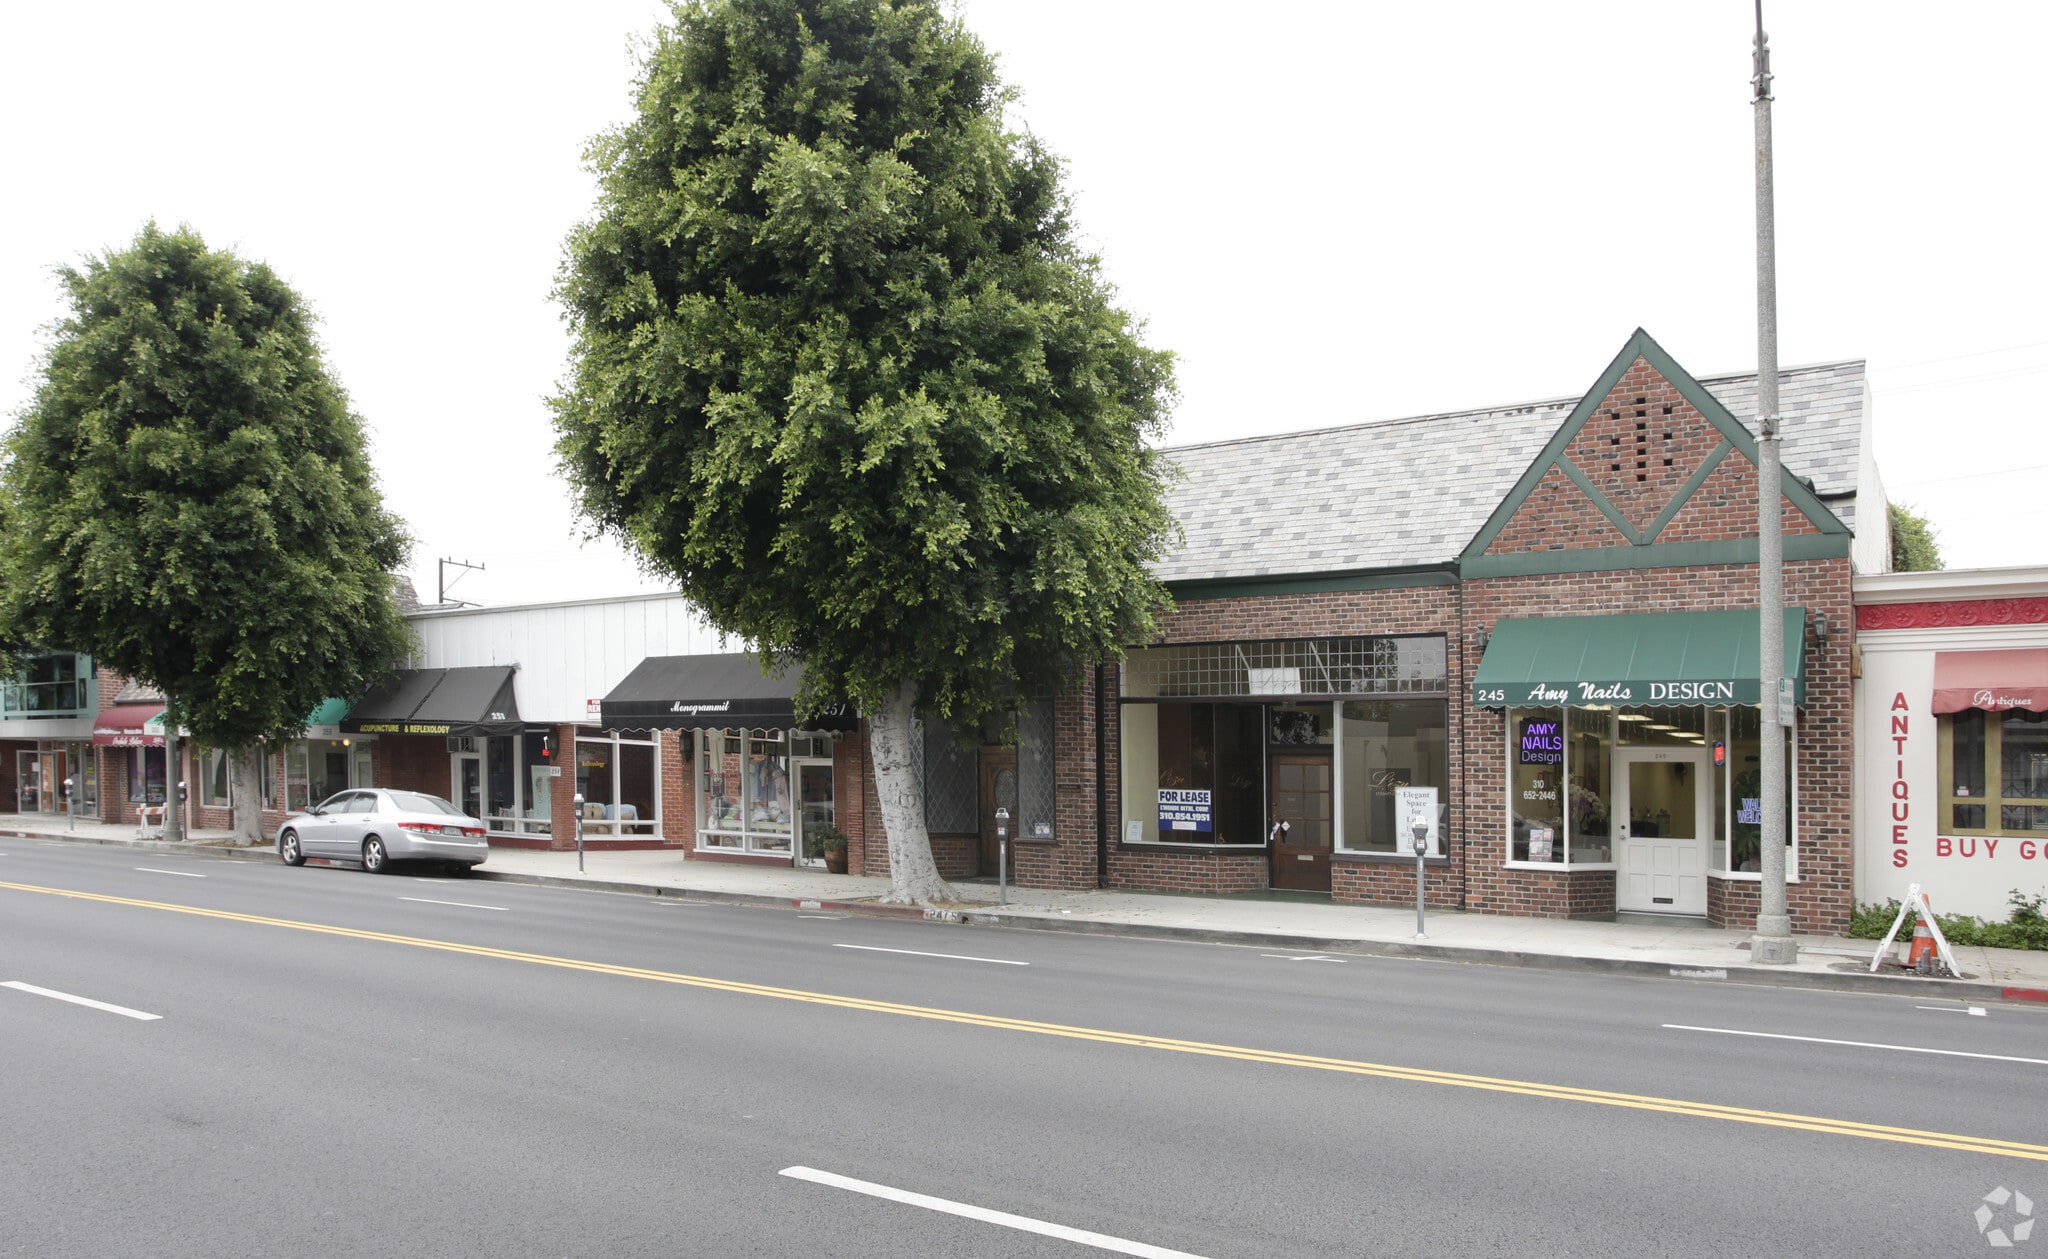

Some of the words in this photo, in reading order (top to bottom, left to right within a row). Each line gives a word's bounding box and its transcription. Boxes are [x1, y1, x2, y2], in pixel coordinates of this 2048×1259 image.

[1478, 689, 1505, 701] 245
[1527, 683, 1569, 703] Amy
[1578, 681, 1632, 700] Nails
[1649, 681, 1734, 700] DESIGN
[1972, 689, 2033, 707] Antiques
[588, 705, 600, 713] REN
[360, 724, 399, 733] ACUPUNCTURE
[404, 724, 409, 733] &
[410, 724, 450, 734] REFLEXOLOGY
[1526, 723, 1557, 735] AMY
[1522, 736, 1562, 750] NAILS
[1521, 751, 1562, 764] Design
[1532, 780, 1544, 789] 310
[1891, 692, 1909, 868] ANTIQUES
[1160, 791, 1178, 802] FOR
[1180, 791, 1209, 803] LEASE
[1403, 791, 1430, 799] Elegant
[1523, 791, 1556, 800] 652-2446
[1406, 800, 1427, 808] Space
[1741, 798, 1761, 811] WAL
[1159, 812, 1210, 821] 310.854.1951
[1737, 810, 1761, 824] WELC
[1937, 838, 1999, 859] BUY
[2020, 840, 2048, 860] G
